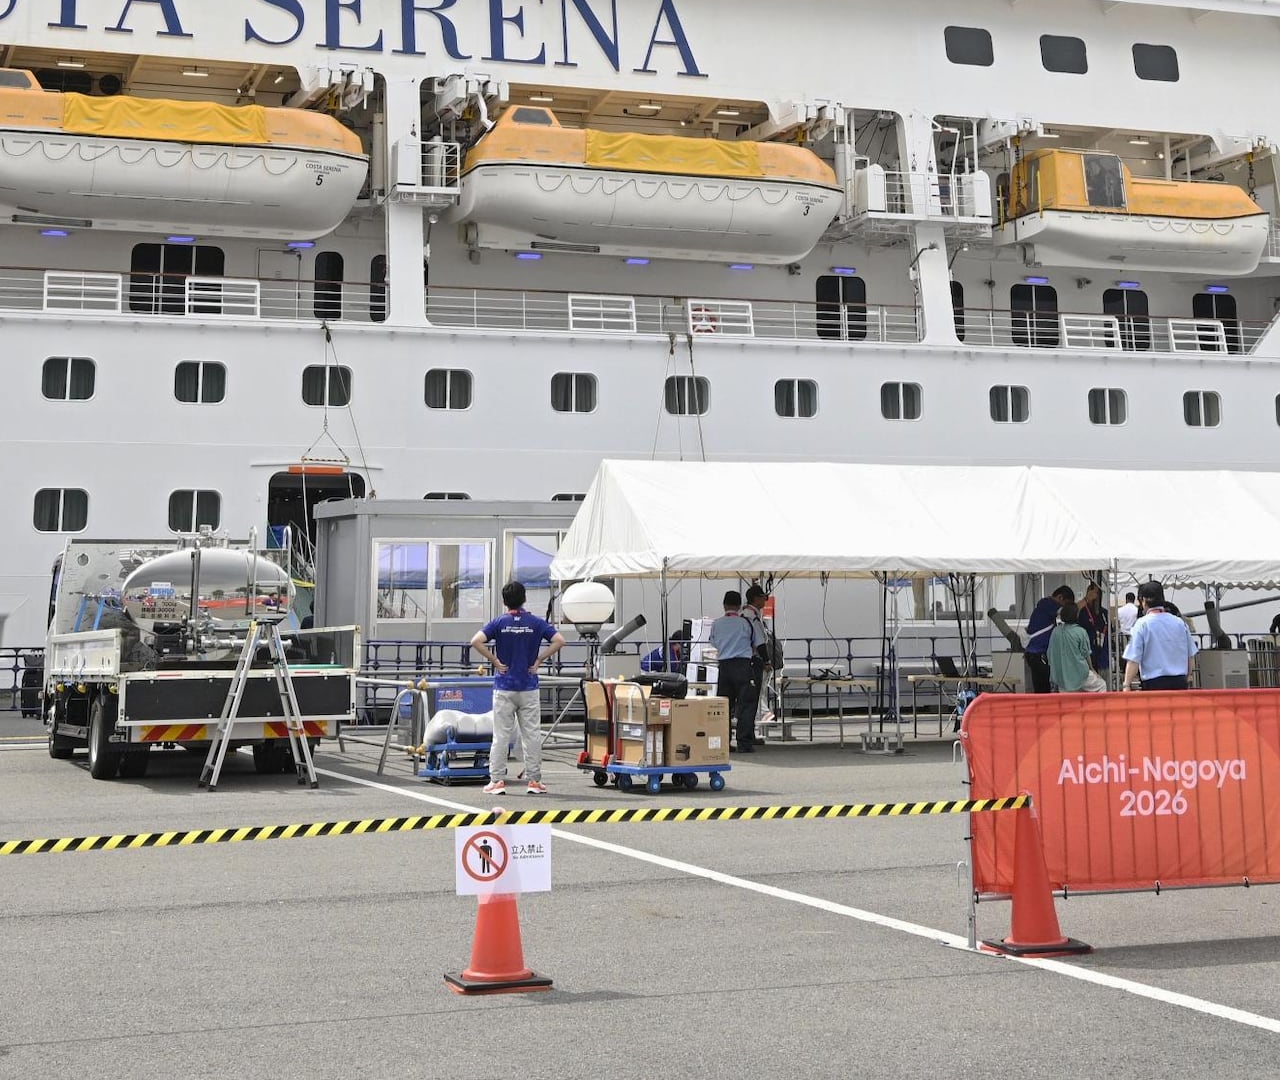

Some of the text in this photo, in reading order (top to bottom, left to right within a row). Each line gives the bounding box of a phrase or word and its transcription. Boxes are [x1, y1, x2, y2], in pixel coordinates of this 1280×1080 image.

[315, 174, 324, 186] 5
[803, 205, 810, 216] 3
[1058, 753, 1246, 789] Aichi-Nagoya
[1119, 789, 1188, 818] 2026
[511, 843, 545, 855] 立入禁止
